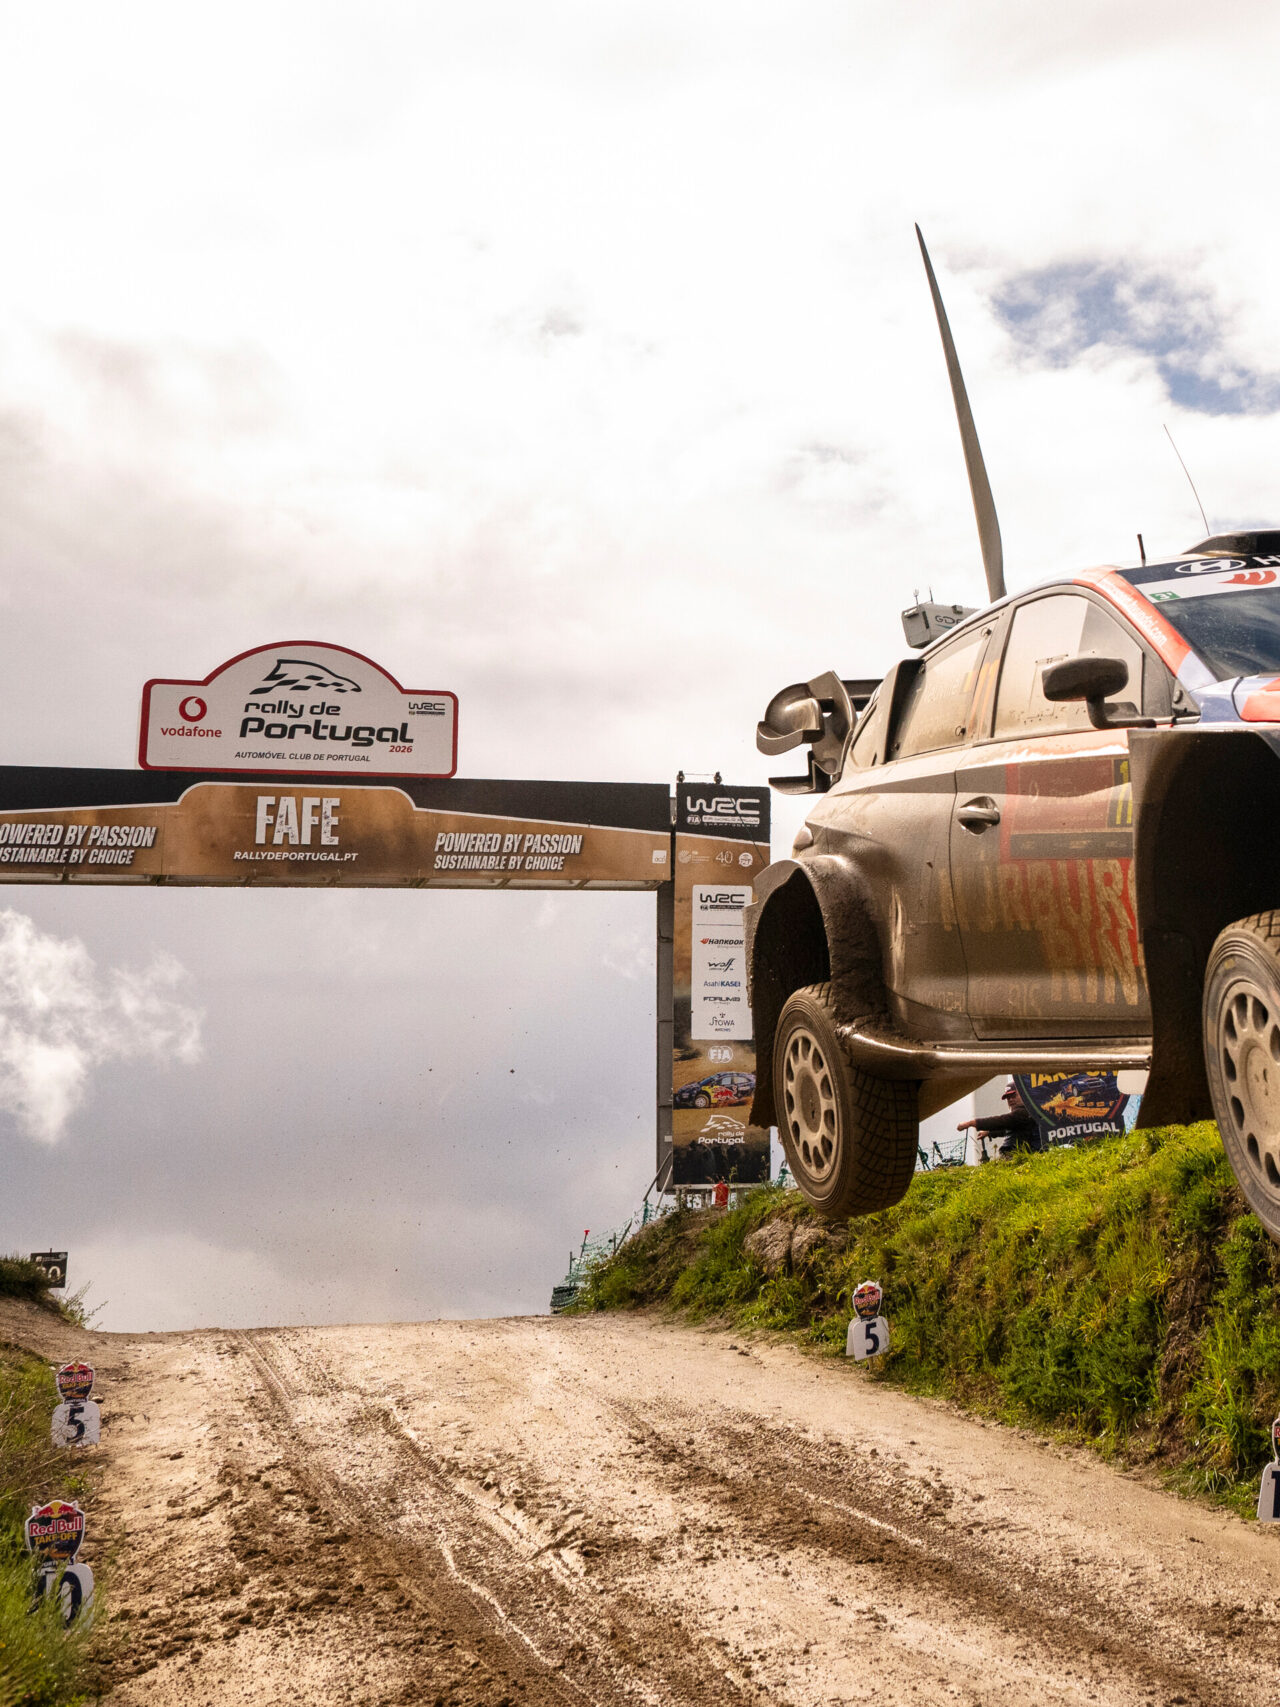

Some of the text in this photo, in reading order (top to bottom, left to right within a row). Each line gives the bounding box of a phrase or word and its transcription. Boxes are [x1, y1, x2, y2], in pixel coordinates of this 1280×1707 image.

[244, 700, 341, 718] rally de
[409, 702, 446, 711] WRC
[160, 725, 223, 738] vodafone
[239, 717, 415, 747] Portugal
[234, 751, 371, 762] AUTOMÓVEL CLUB DE PORTUGAL
[388, 745, 413, 753] 2026
[687, 796, 760, 814] WRC
[255, 796, 341, 846] FAFE
[0, 823, 157, 847] OWERED BY PASSION
[434, 833, 583, 854] POWERED BY PASSION
[0, 847, 135, 865] STAINABLE BY CHOICE
[233, 851, 359, 862] RALLYDEPORTUGAL.PT
[433, 855, 566, 871] SUSTAINABLE BY CHOICE
[716, 851, 734, 864] 40
[700, 893, 745, 903] WRC
[709, 1050, 731, 1061] FIA
[1047, 1121, 1120, 1142] PORTUGAL
[697, 1136, 746, 1146] Portugal
[865, 1322, 880, 1355] 5
[59, 1371, 93, 1384] Red Bull
[66, 1406, 85, 1443] 5
[29, 1516, 82, 1537] Red Bull
